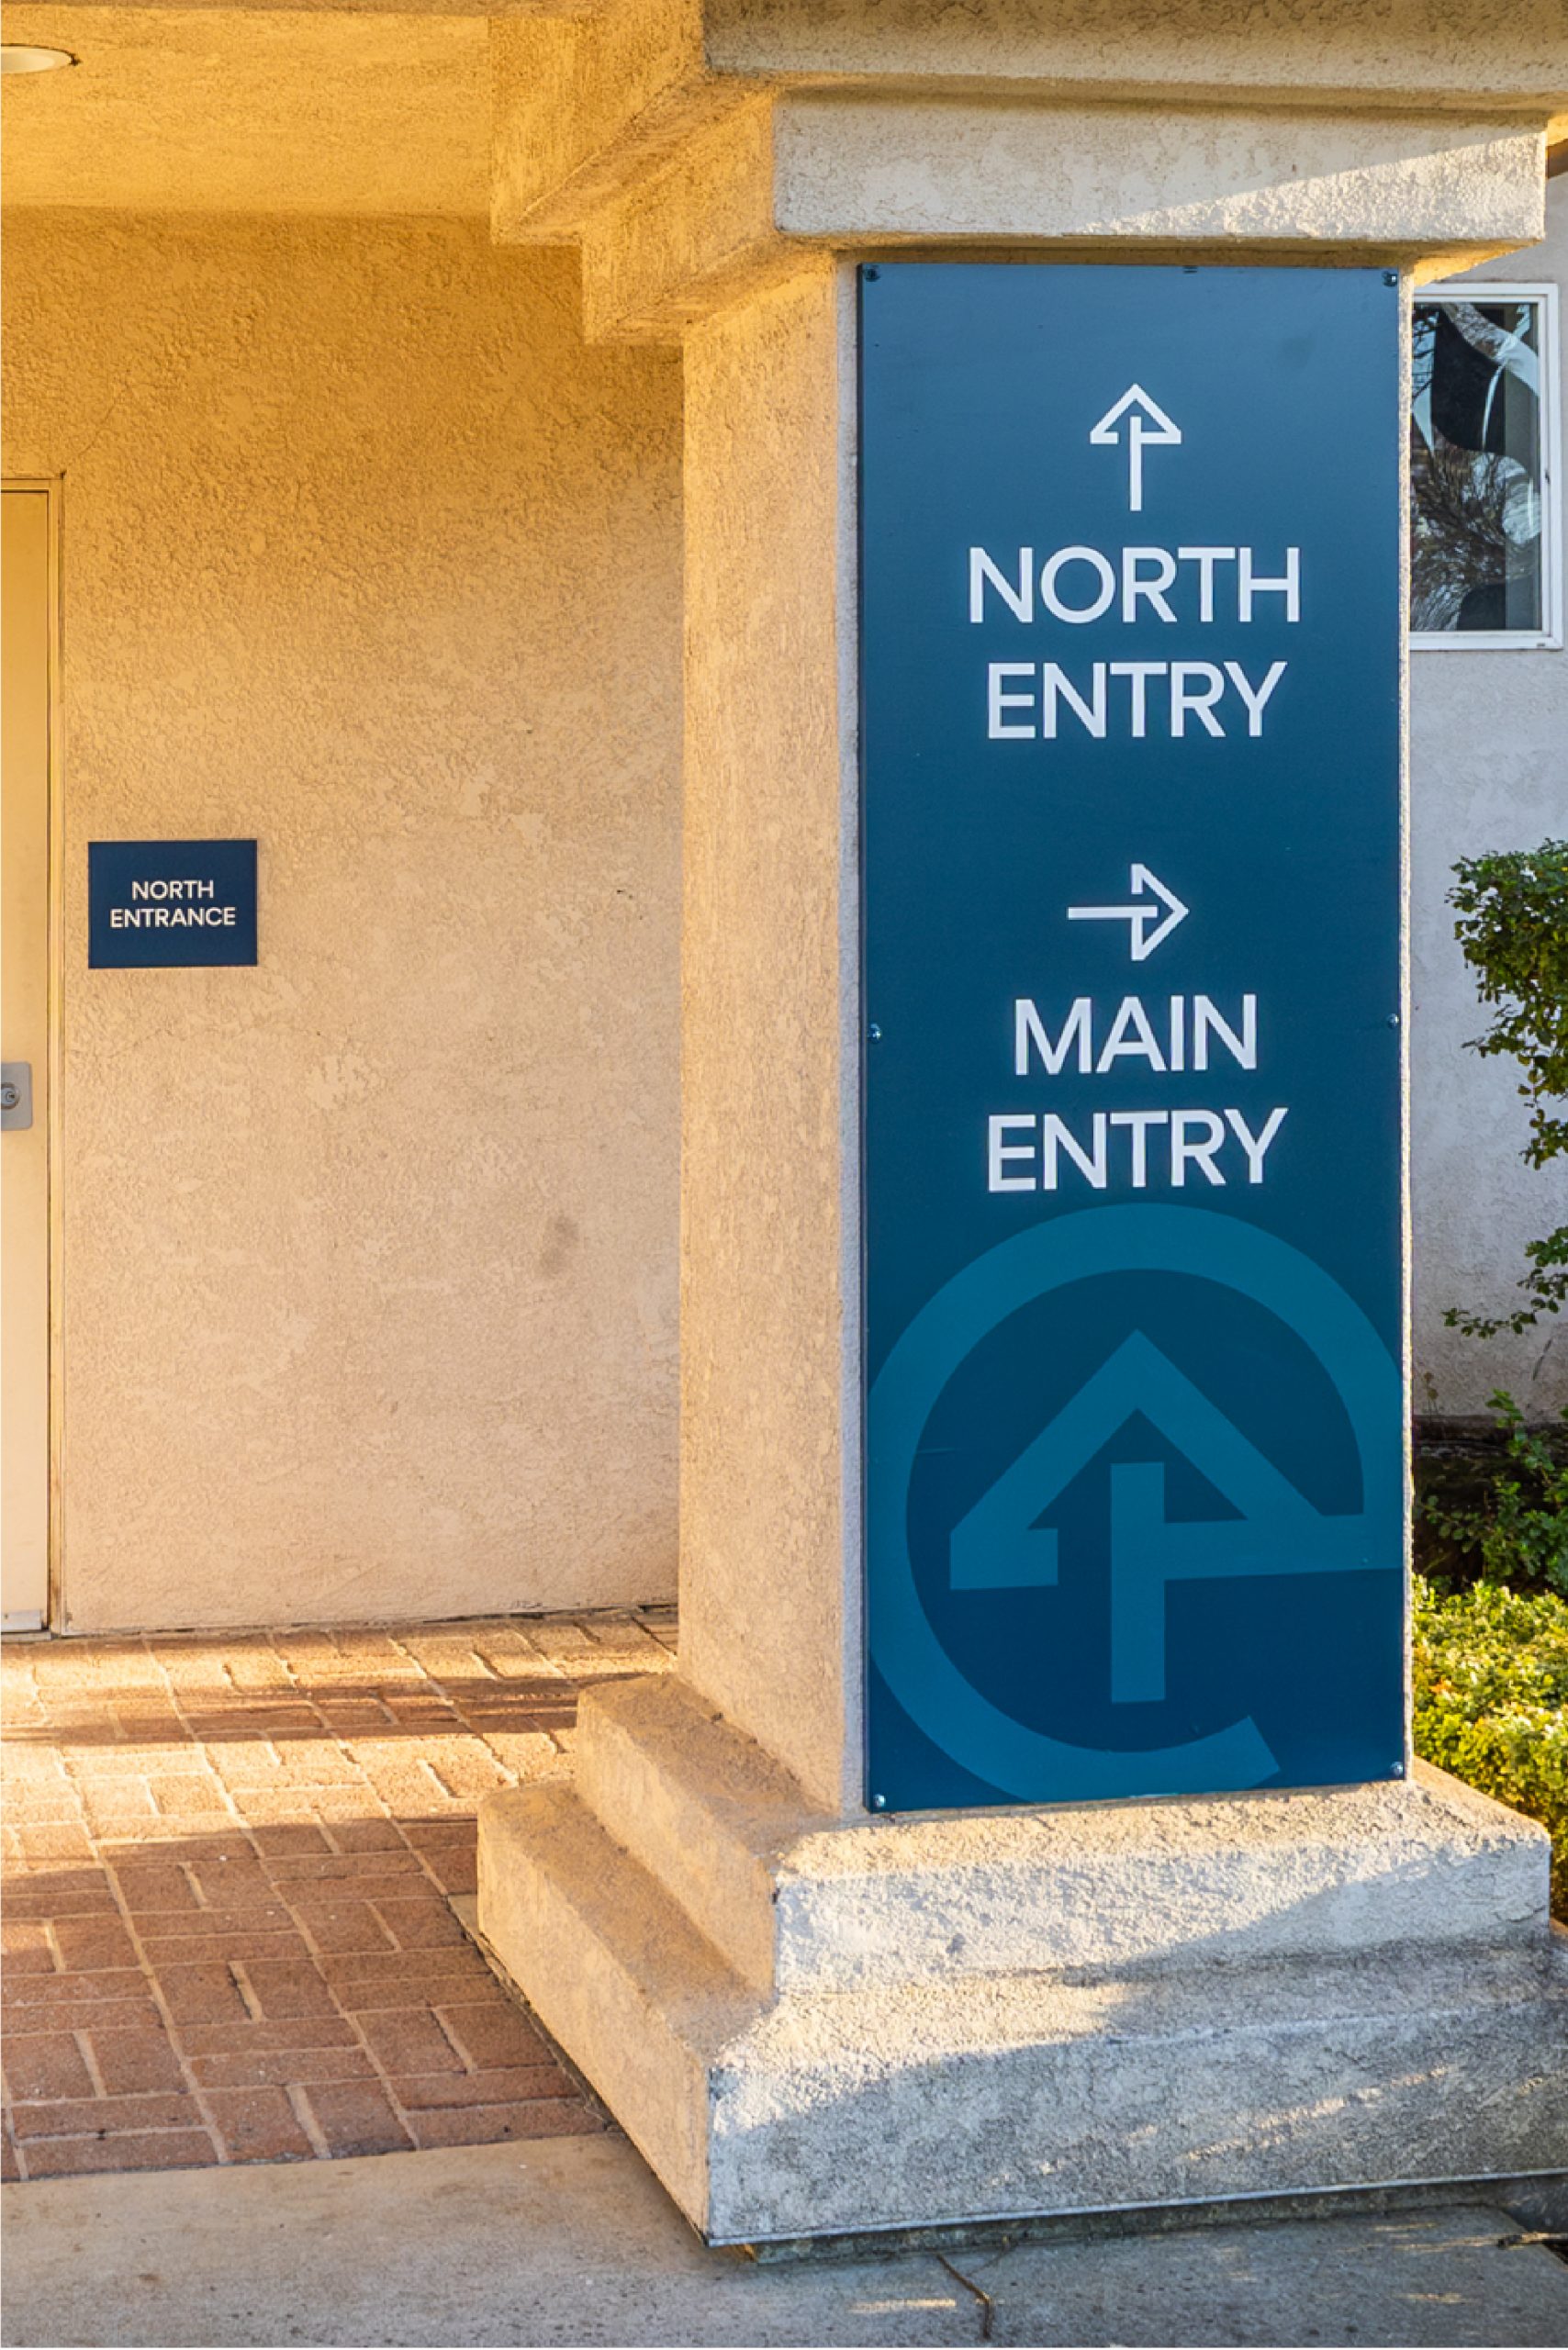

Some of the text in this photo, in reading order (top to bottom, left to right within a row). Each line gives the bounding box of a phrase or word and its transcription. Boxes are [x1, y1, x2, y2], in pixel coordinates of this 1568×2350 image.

[969, 546, 1300, 624] NORTH
[988, 662, 1288, 739] ENTRY
[109, 906, 236, 928] ENTRANCE
[131, 879, 214, 901] NORTH
[1015, 994, 1257, 1076] MAIN
[988, 1108, 1288, 1192] ENTRY
